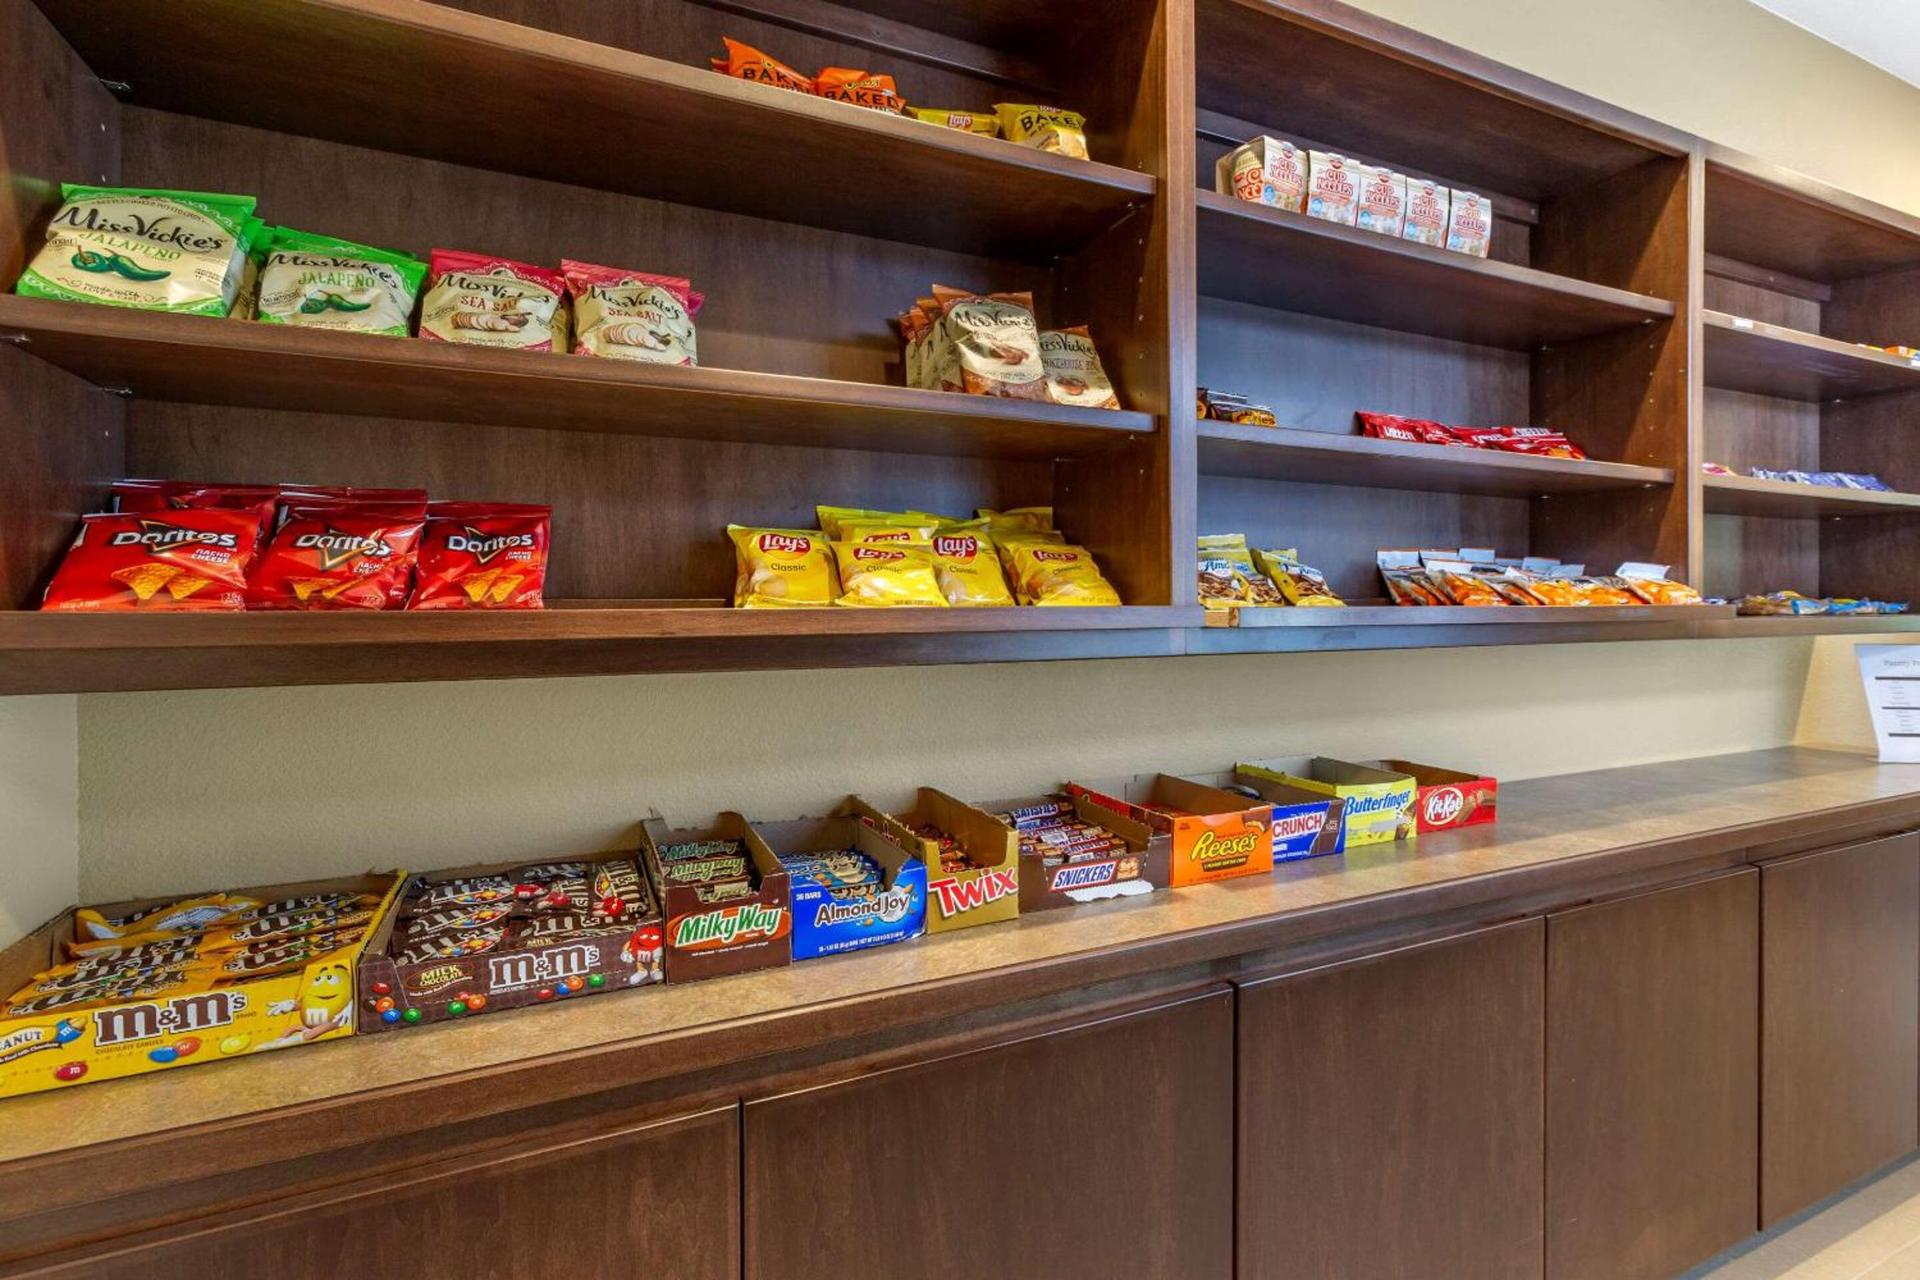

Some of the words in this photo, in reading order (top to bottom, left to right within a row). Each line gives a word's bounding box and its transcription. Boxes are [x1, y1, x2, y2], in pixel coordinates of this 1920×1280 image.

[824, 90, 900, 108] BAKED
[54, 206, 136, 234] Miss
[129, 214, 224, 254] Vickie's
[269, 253, 329, 267] Miss
[460, 295, 487, 311] SEA
[492, 298, 518, 313] SALT
[621, 292, 682, 321] Vickie's
[636, 309, 663, 325] SALT
[954, 309, 994, 329] Miss
[112, 529, 237, 548] Doritos
[294, 533, 394, 557] Doritos
[448, 533, 534, 553] Doritos
[762, 533, 808, 553] Lay's
[937, 536, 976, 558] Lay's
[770, 562, 807, 572] Classic
[1344, 790, 1411, 816] Butterfinger
[1273, 814, 1322, 838] CRUNCH
[1190, 831, 1259, 861] Reese's
[1054, 863, 1115, 888] SNICKERS
[815, 895, 881, 927] Almond
[880, 893, 909, 914] Joy
[675, 910, 738, 947] Milky
[734, 903, 783, 937] Way
[420, 964, 461, 981] MILK
[420, 972, 463, 987] CHOCOLATE
